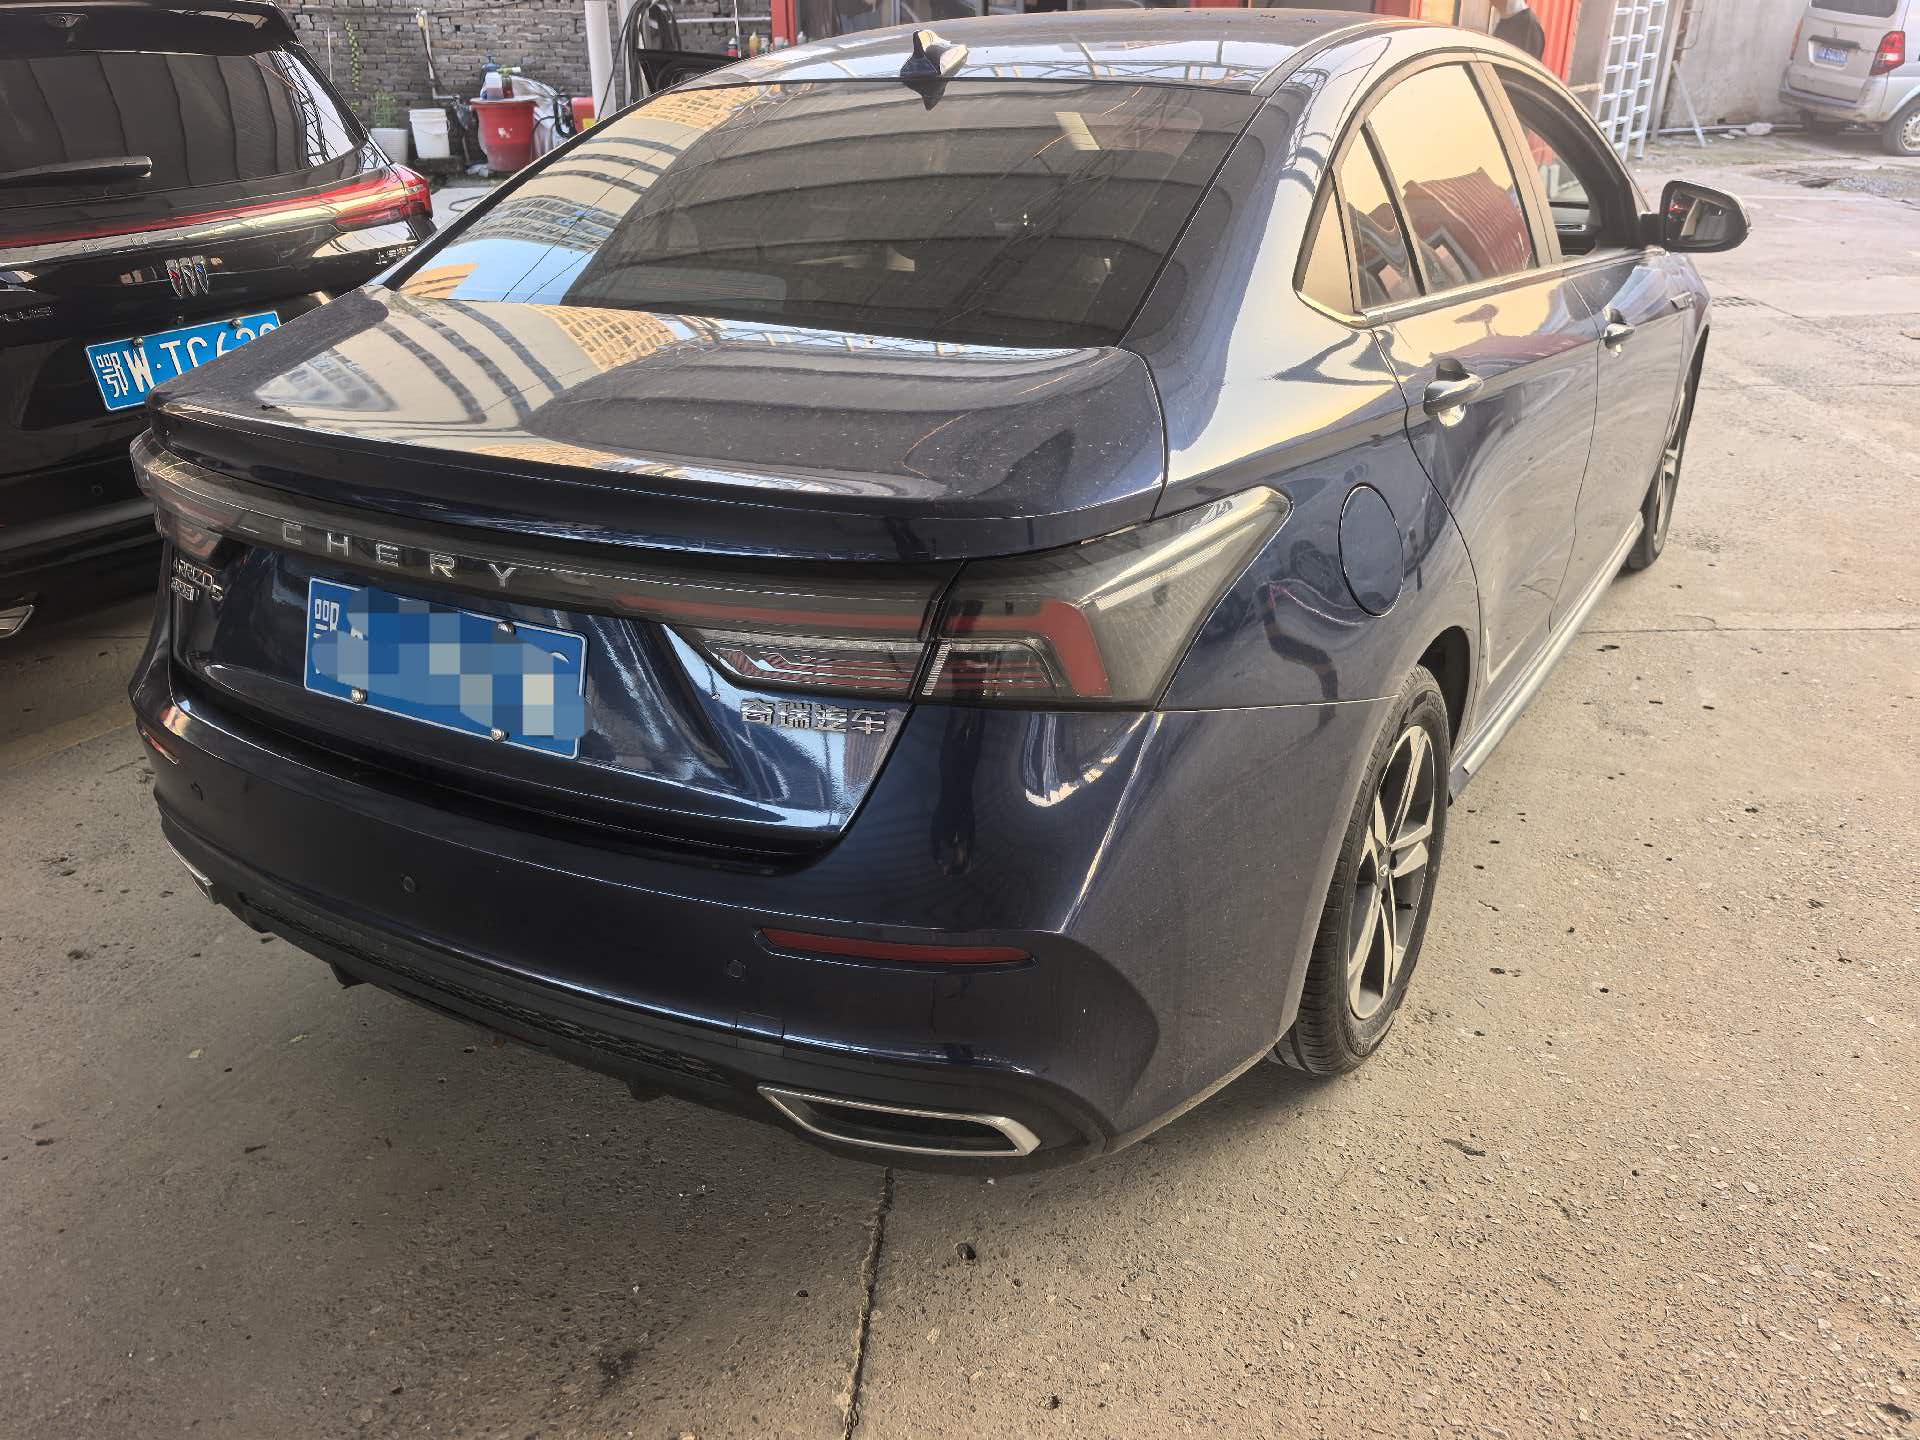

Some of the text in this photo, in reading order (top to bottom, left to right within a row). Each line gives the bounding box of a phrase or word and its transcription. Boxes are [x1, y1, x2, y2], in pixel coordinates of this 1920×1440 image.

[282, 521, 516, 588] CHERY
[740, 699, 886, 735] 奇瑞汽车
